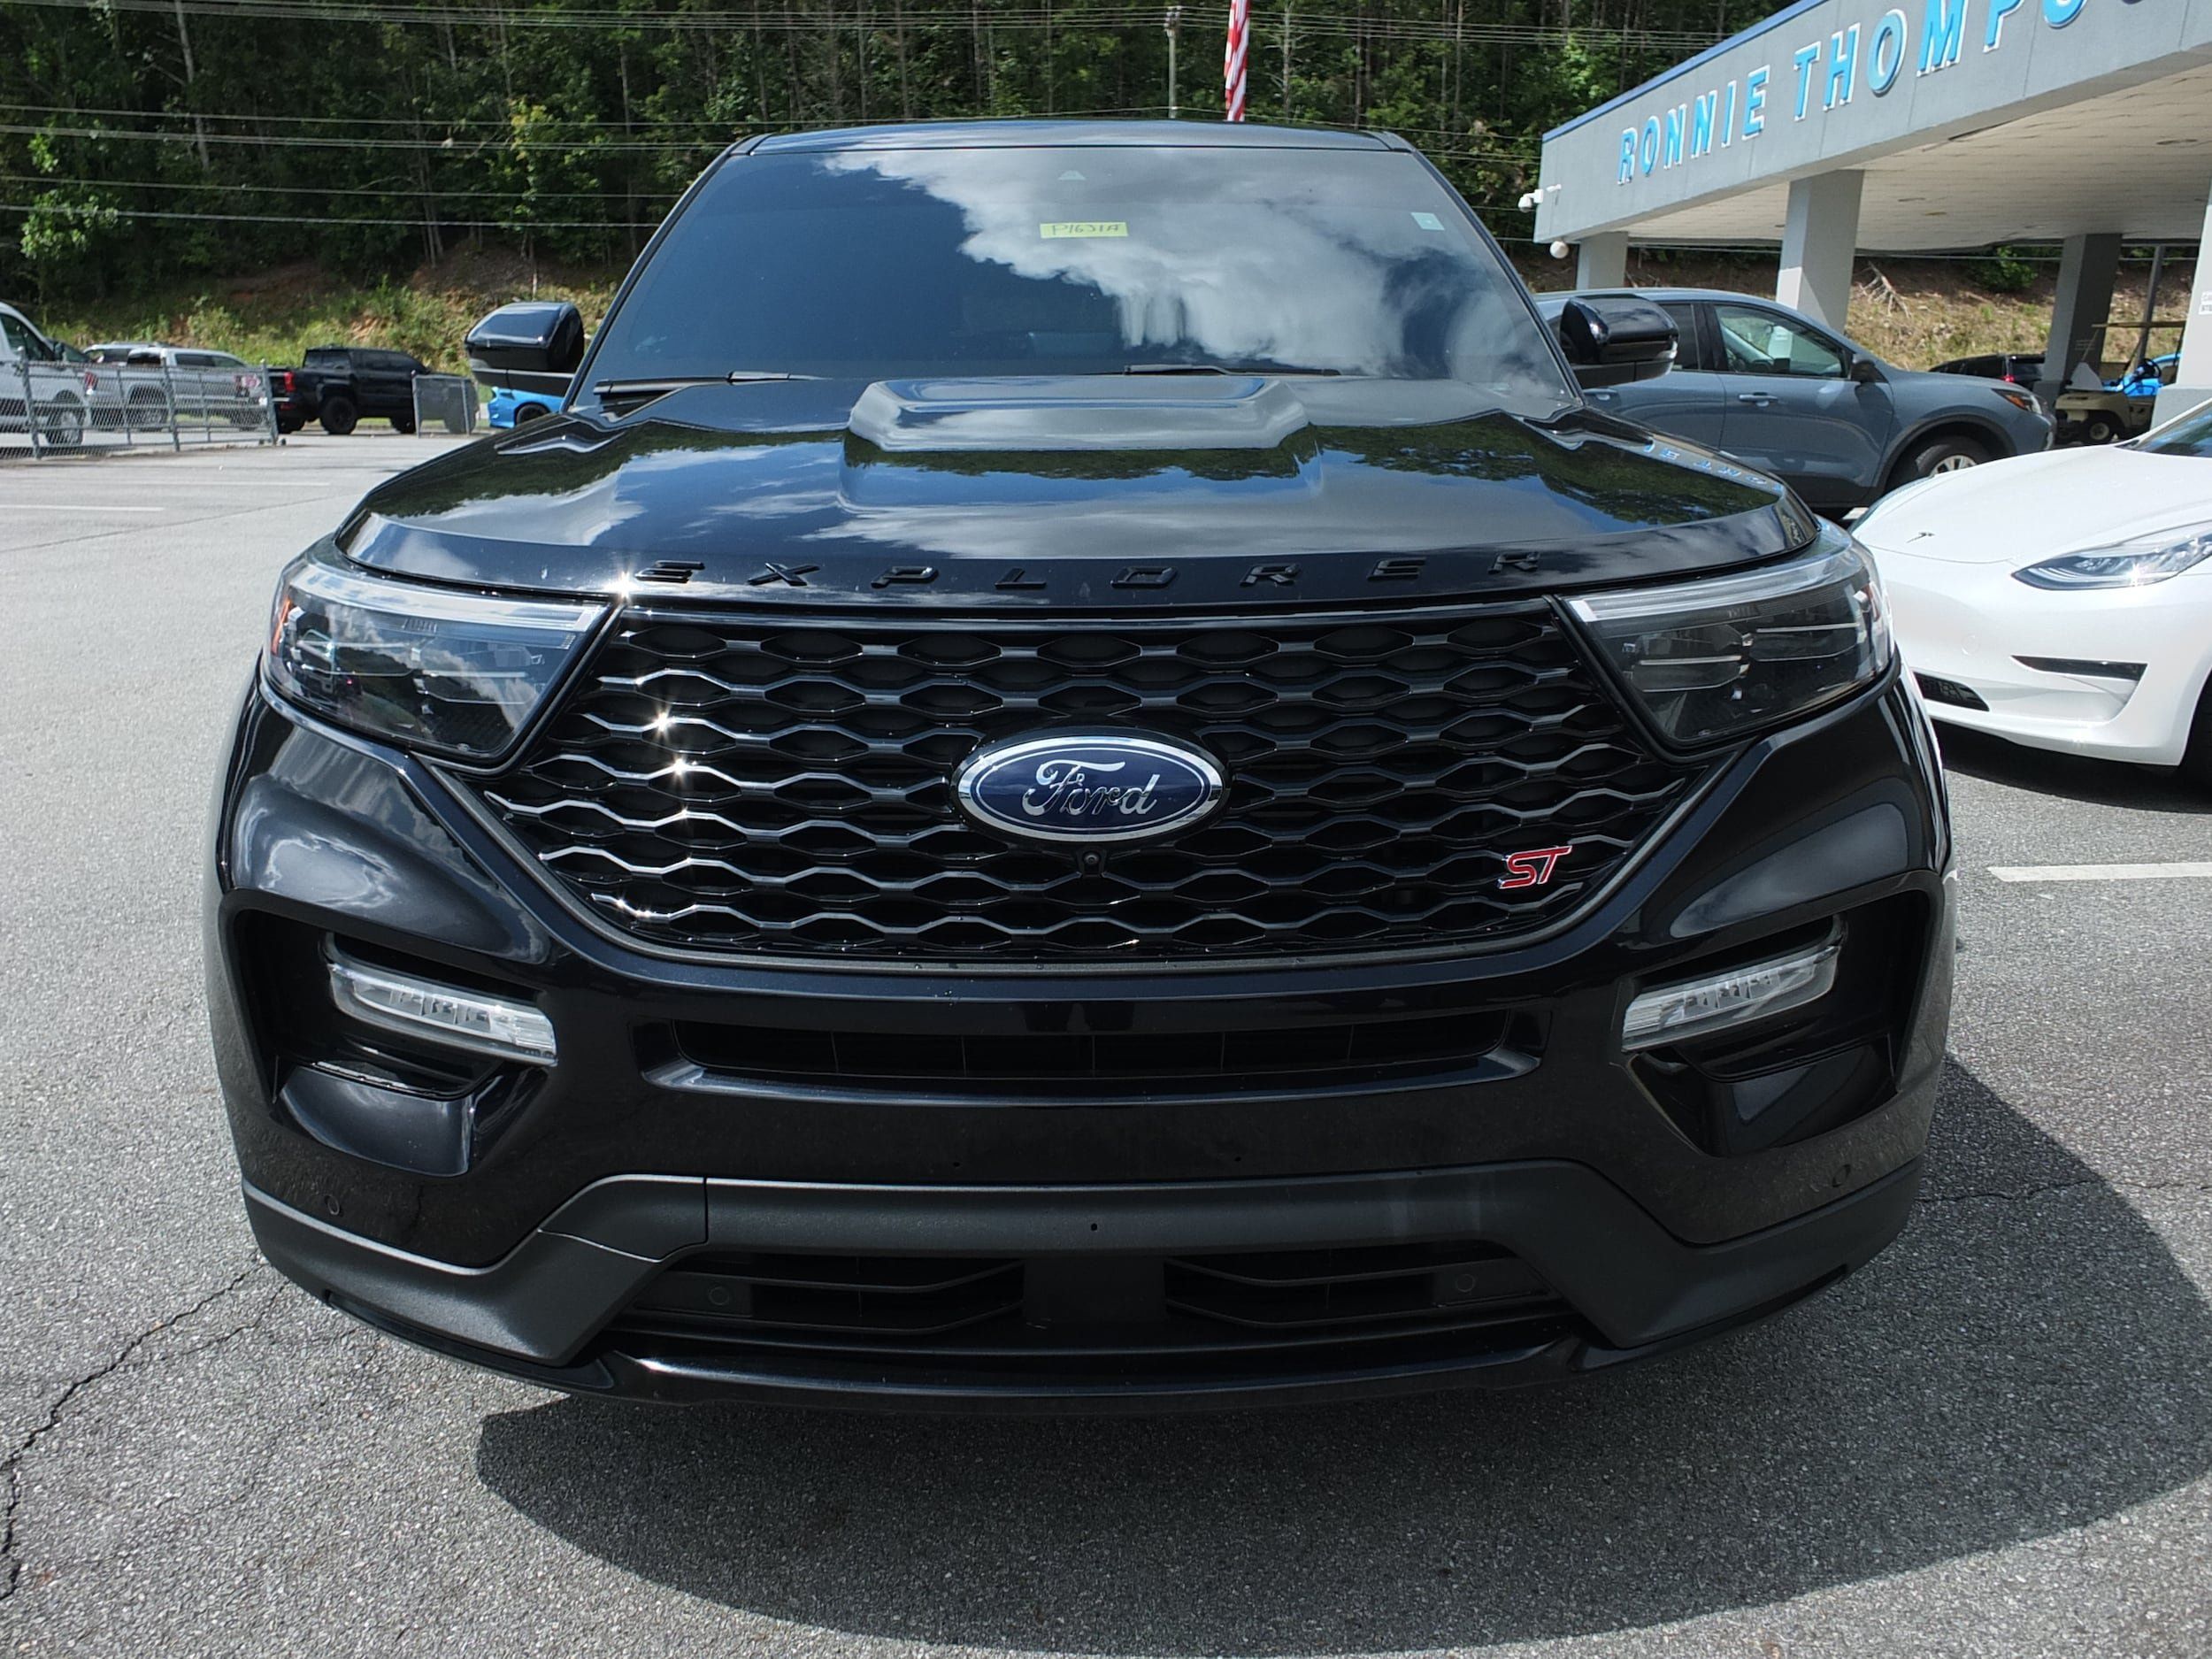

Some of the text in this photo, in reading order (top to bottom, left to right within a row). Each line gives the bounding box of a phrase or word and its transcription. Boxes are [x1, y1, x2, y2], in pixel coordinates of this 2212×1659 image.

[1617, 65, 1770, 185] RONNIE
[634, 551, 1541, 590] EXPLORER
[1022, 759, 1161, 816] Ford
[1497, 845, 1573, 889] ST
